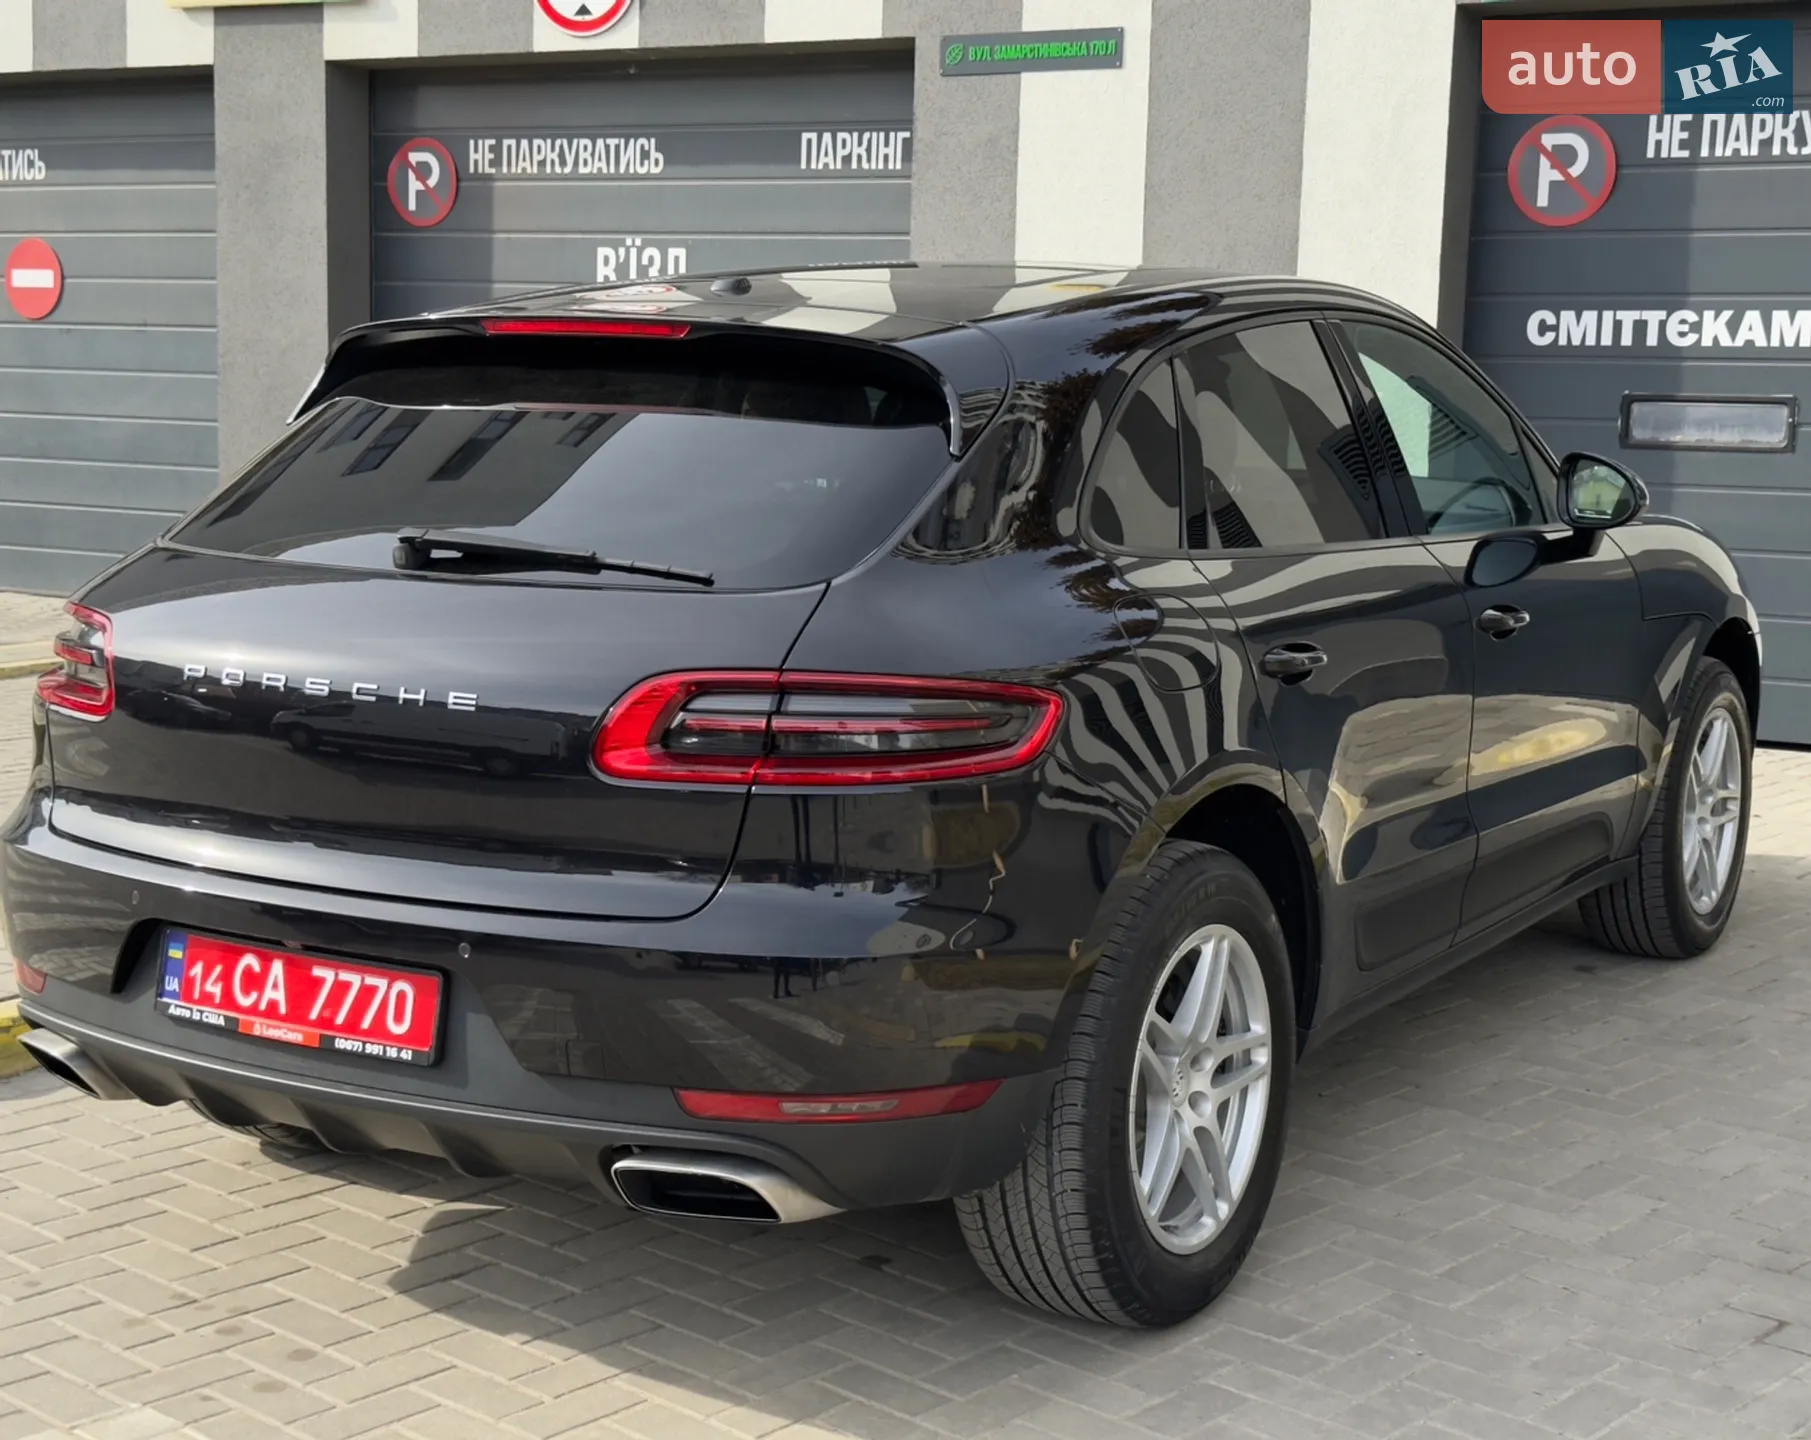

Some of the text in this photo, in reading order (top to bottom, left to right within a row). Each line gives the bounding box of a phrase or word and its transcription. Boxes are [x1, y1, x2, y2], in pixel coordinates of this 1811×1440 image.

[469, 137, 664, 175] НЕ ПАРКУВАТИСЬ
[800, 131, 911, 170] ПАРКІНГ
[1646, 114, 1693, 159] НЕ
[183, 664, 478, 711] PORSCHE
[164, 975, 180, 993] UA
[189, 960, 223, 1004] 14
[308, 965, 415, 1035] 7770
[334, 1037, 363, 1051] (067)
